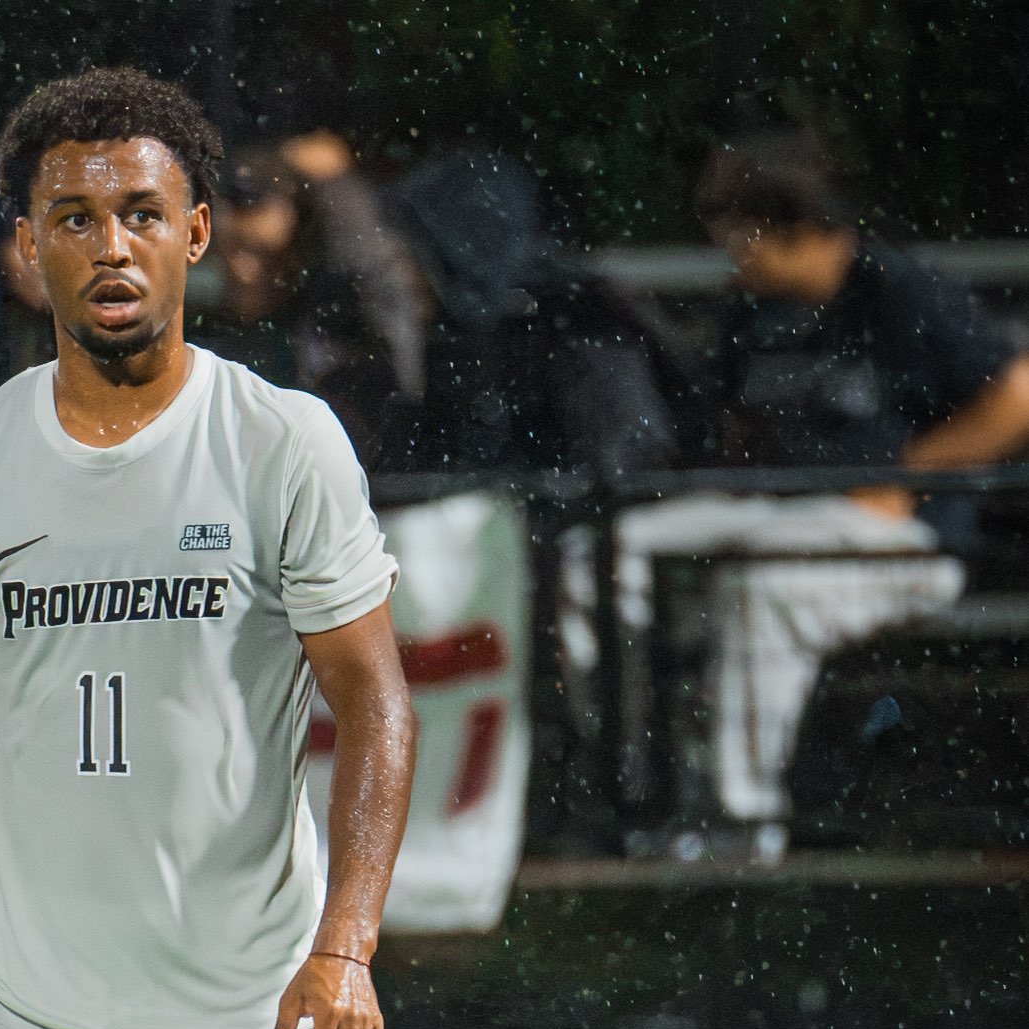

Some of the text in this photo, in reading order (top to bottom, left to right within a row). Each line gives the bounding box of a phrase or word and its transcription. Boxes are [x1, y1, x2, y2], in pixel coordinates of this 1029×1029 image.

[180, 536, 231, 550] CHANGE
[184, 524, 229, 538] BE THE
[0, 576, 230, 640] PROVIDENCE
[76, 672, 130, 775] 11
